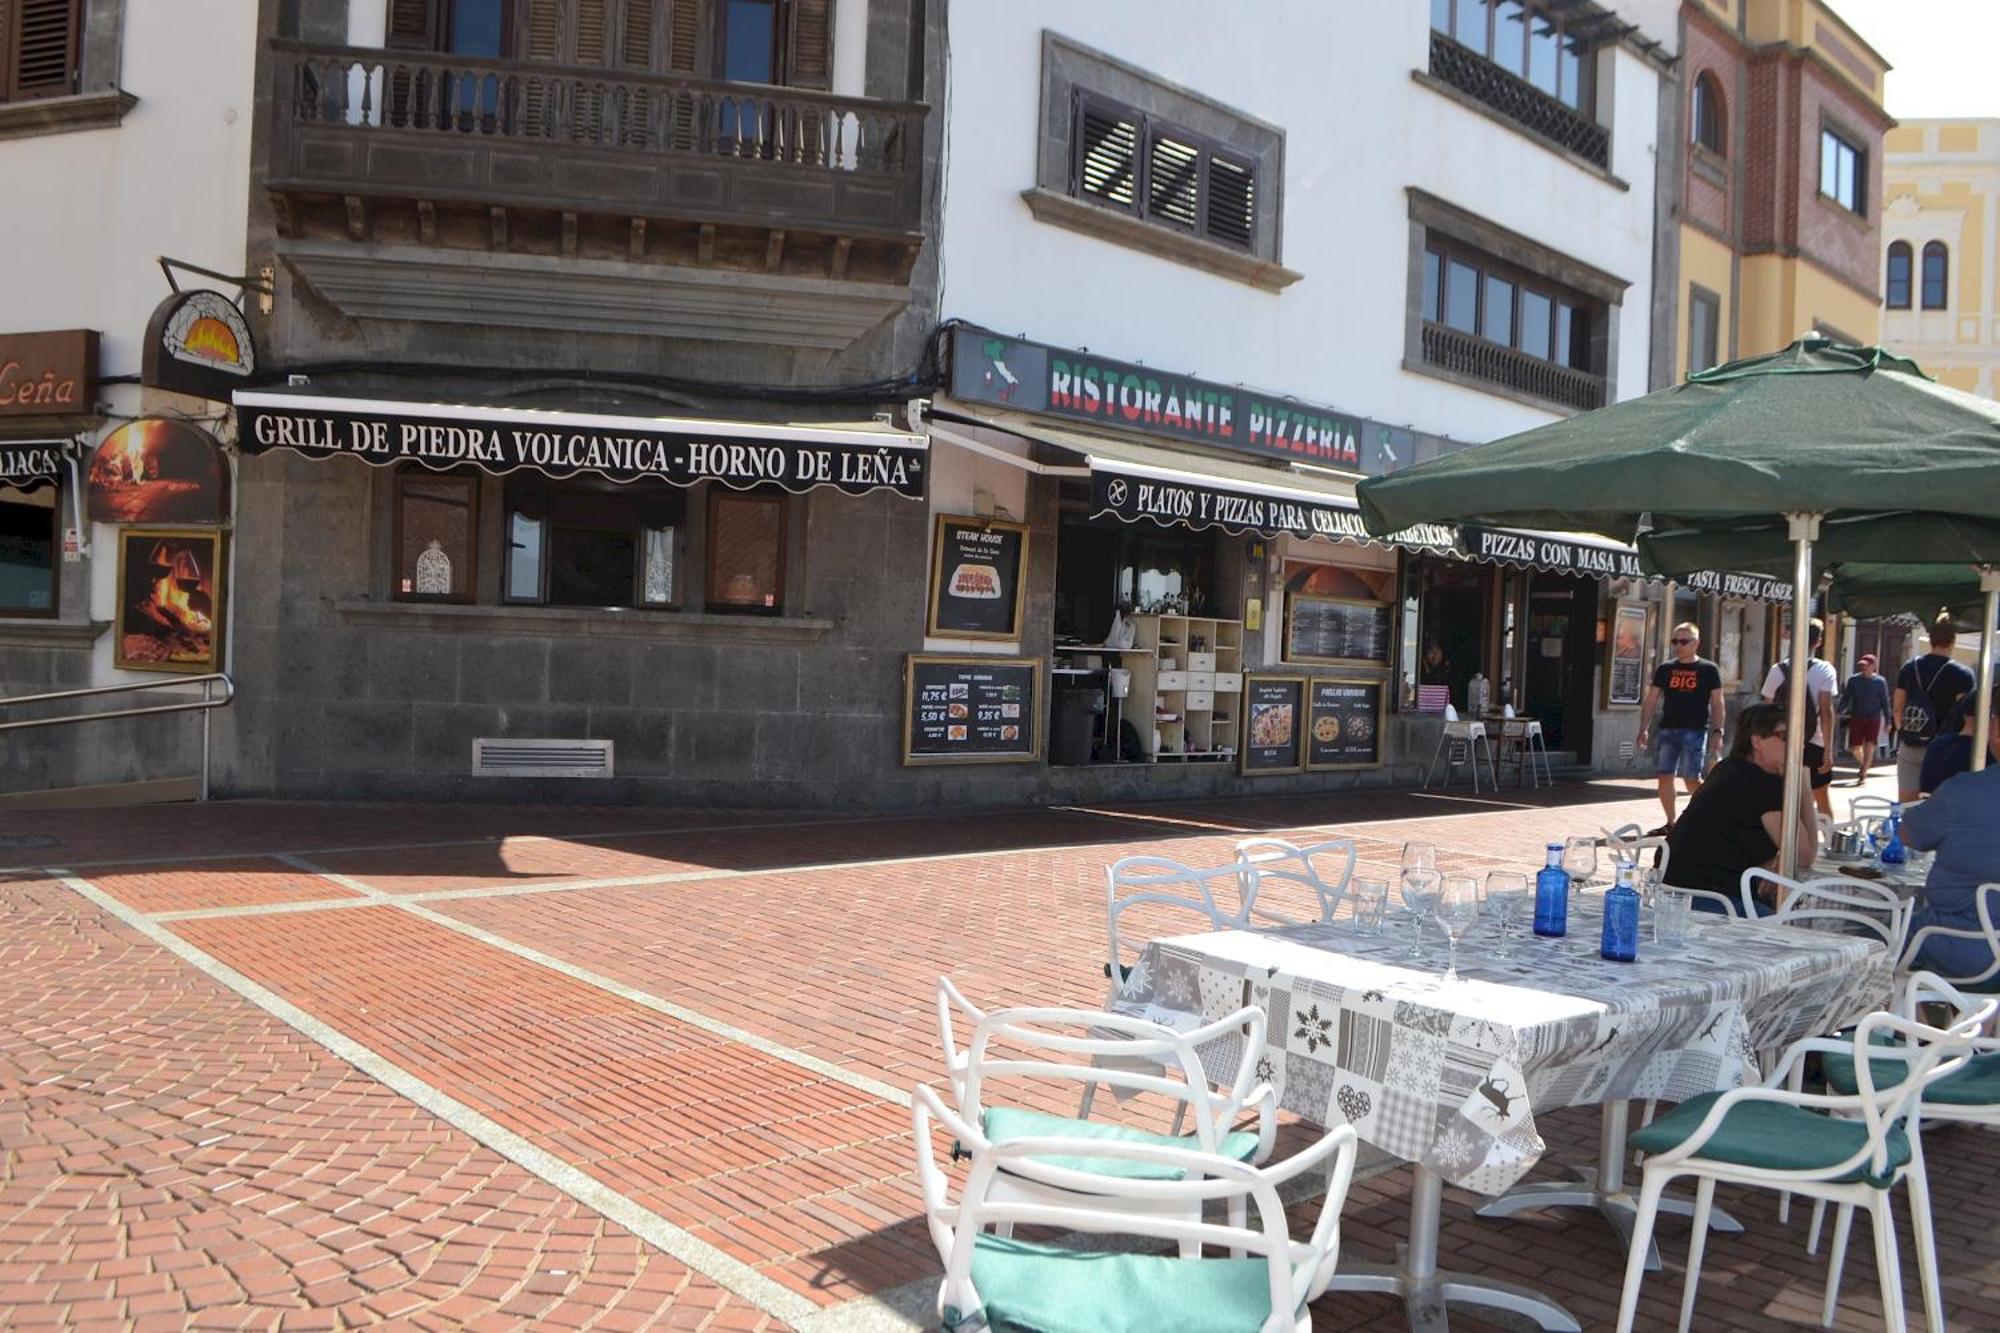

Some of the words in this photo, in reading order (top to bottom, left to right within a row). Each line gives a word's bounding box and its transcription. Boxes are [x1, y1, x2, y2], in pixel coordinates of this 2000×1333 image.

[1052, 360, 1233, 437] RISTORANTE
[1249, 402, 1358, 463] PIZZERIA
[254, 414, 342, 449] GRILL
[350, 421, 389, 453] DE
[400, 424, 505, 461] PIEDRA
[512, 431, 669, 472] VOLCANICA
[687, 443, 786, 478] HORNO
[796, 449, 833, 481] DE
[840, 448, 909, 484] LEÑA
[1137, 484, 1194, 516] PLATOS
[1200, 493, 1211, 519] Y
[1214, 495, 1264, 526] PIZZAS
[1269, 502, 1306, 531] PARA
[1311, 508, 1371, 538] CELIACO
[1481, 532, 1535, 561] PIZZAS
[1540, 543, 1571, 566] CON
[1577, 547, 1615, 573] MASA
[1619, 554, 1645, 577] MA
[1724, 574, 1760, 597] FRESCA
[1762, 580, 1793, 600] CASER
[922, 691, 939, 701] 11,75
[1669, 676, 1697, 689] BIG
